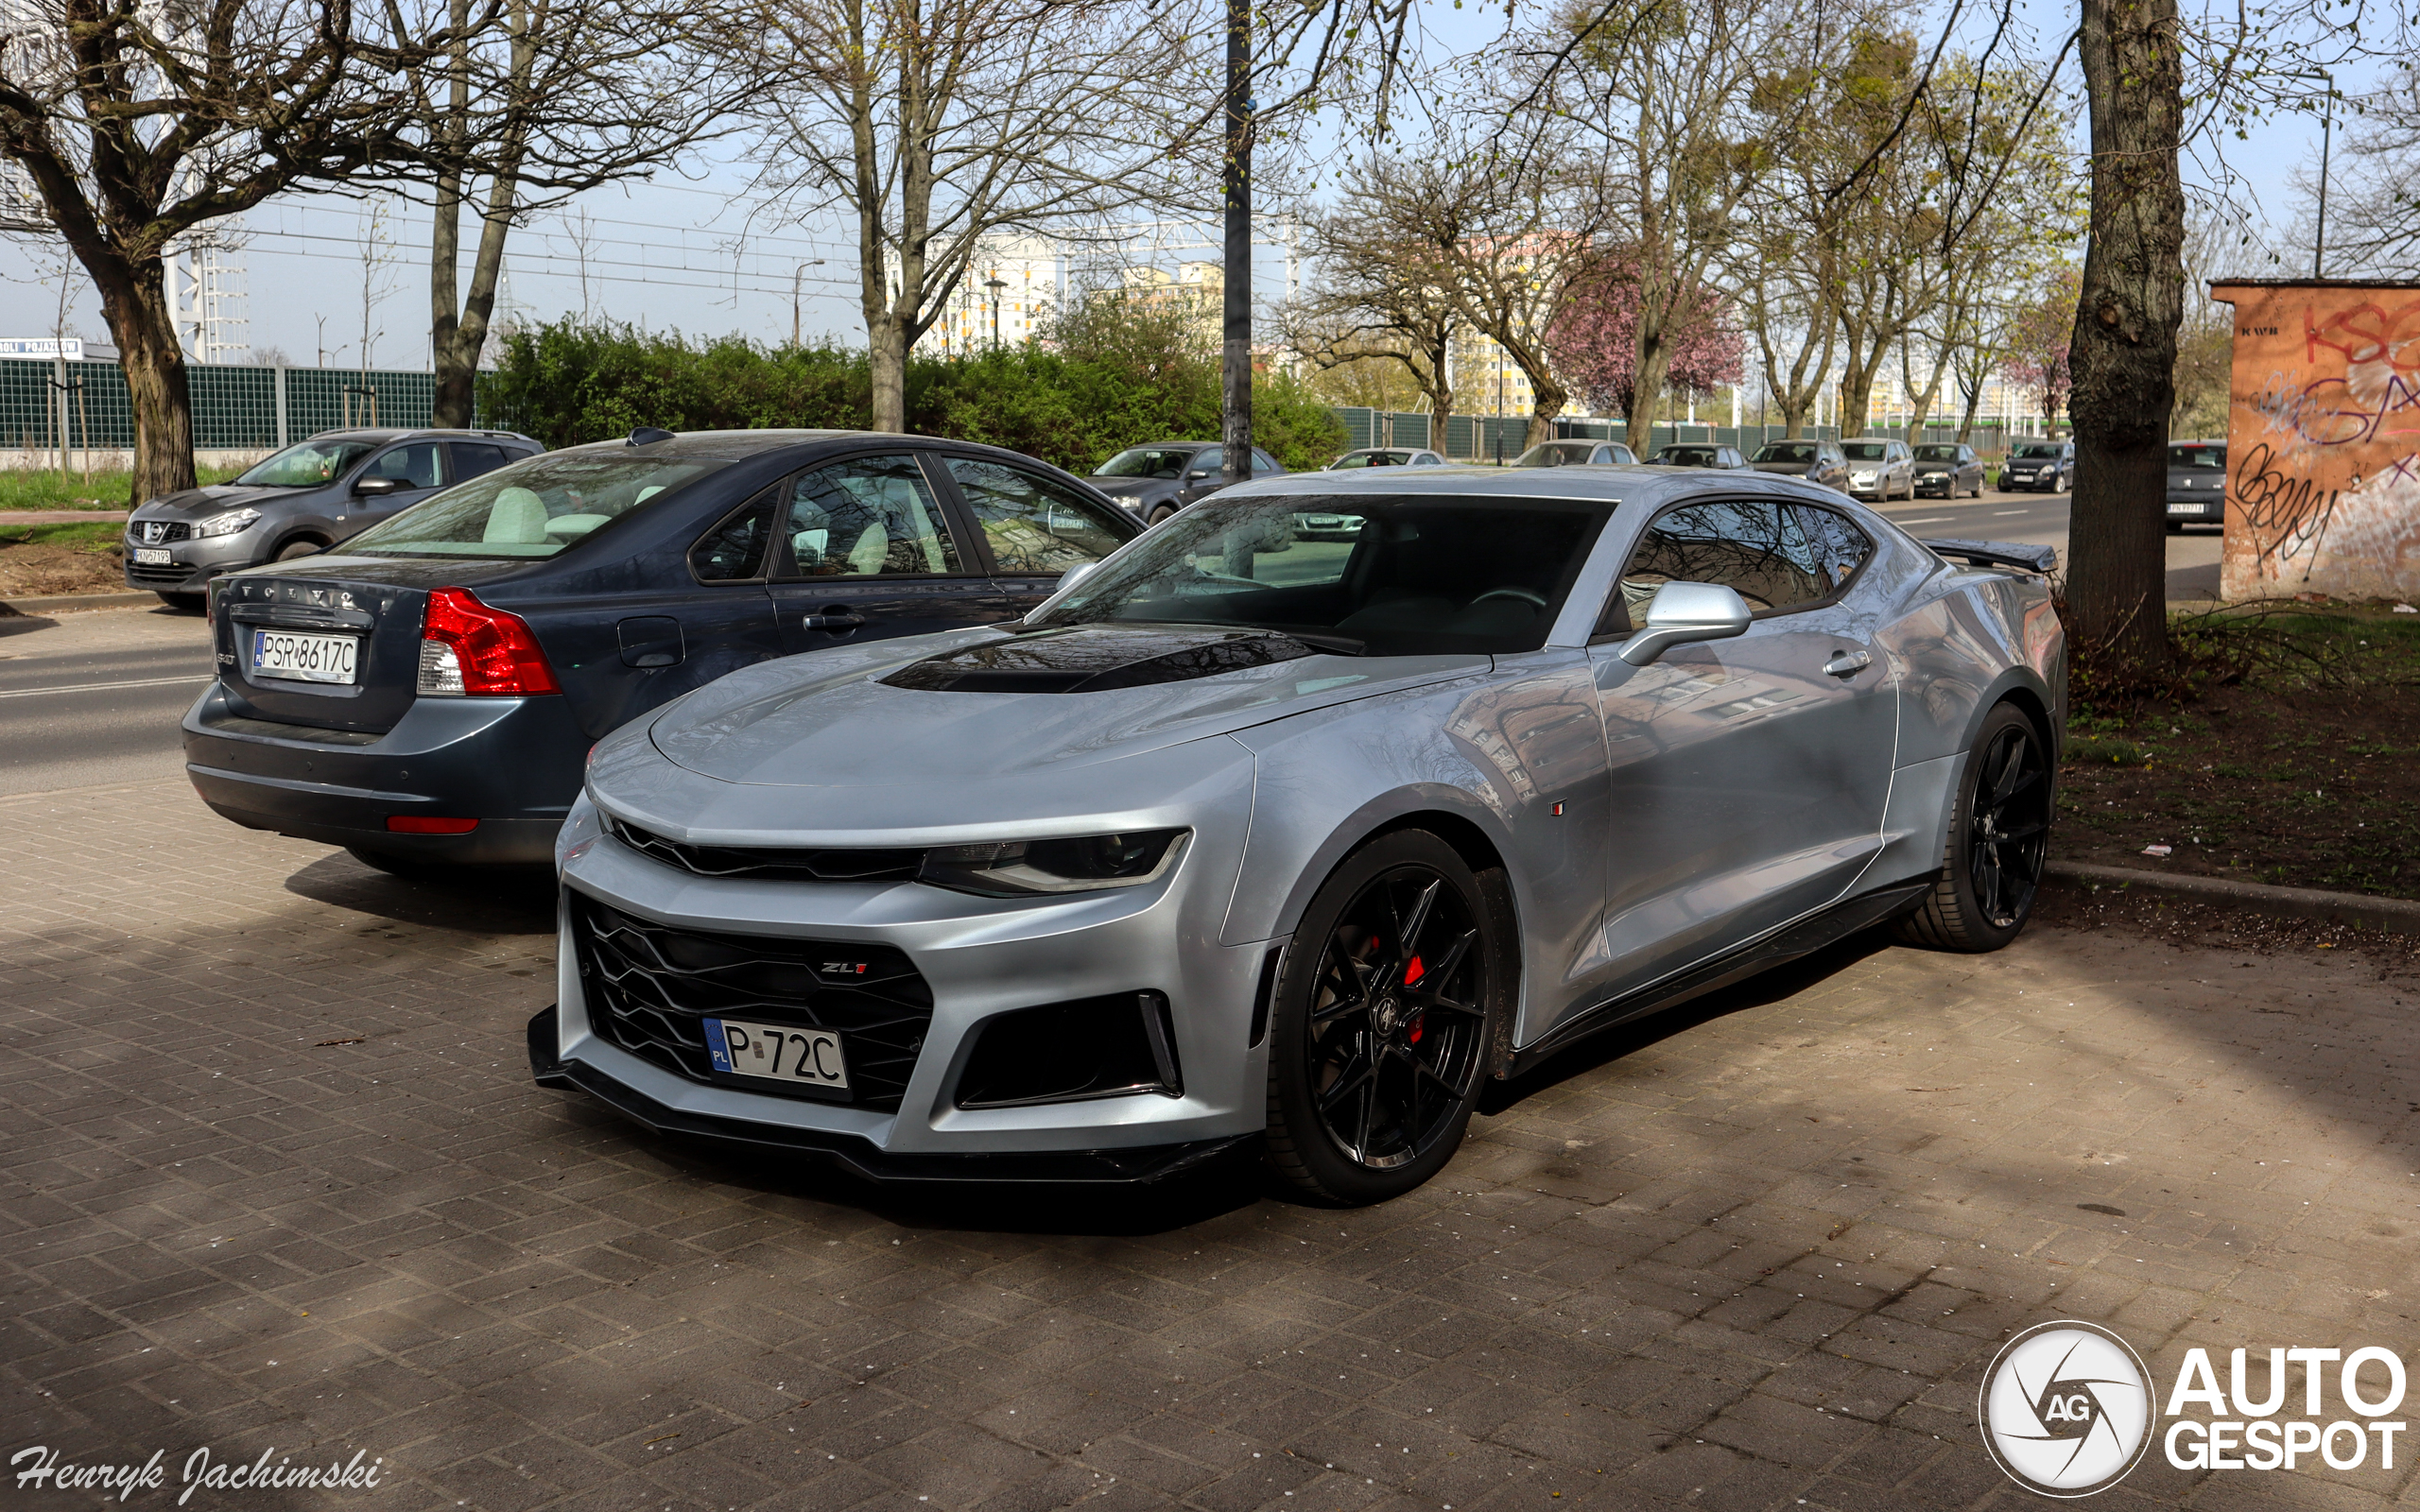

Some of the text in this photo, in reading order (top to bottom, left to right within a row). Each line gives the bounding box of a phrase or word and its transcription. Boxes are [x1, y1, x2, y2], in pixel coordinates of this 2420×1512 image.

[136, 550, 148, 560] PKN
[241, 586, 353, 602] VOLVO
[263, 636, 354, 673] PSR 8617C
[821, 962, 868, 974] ZL1
[712, 1050, 728, 1063] PL
[724, 1025, 840, 1081] P 72C
